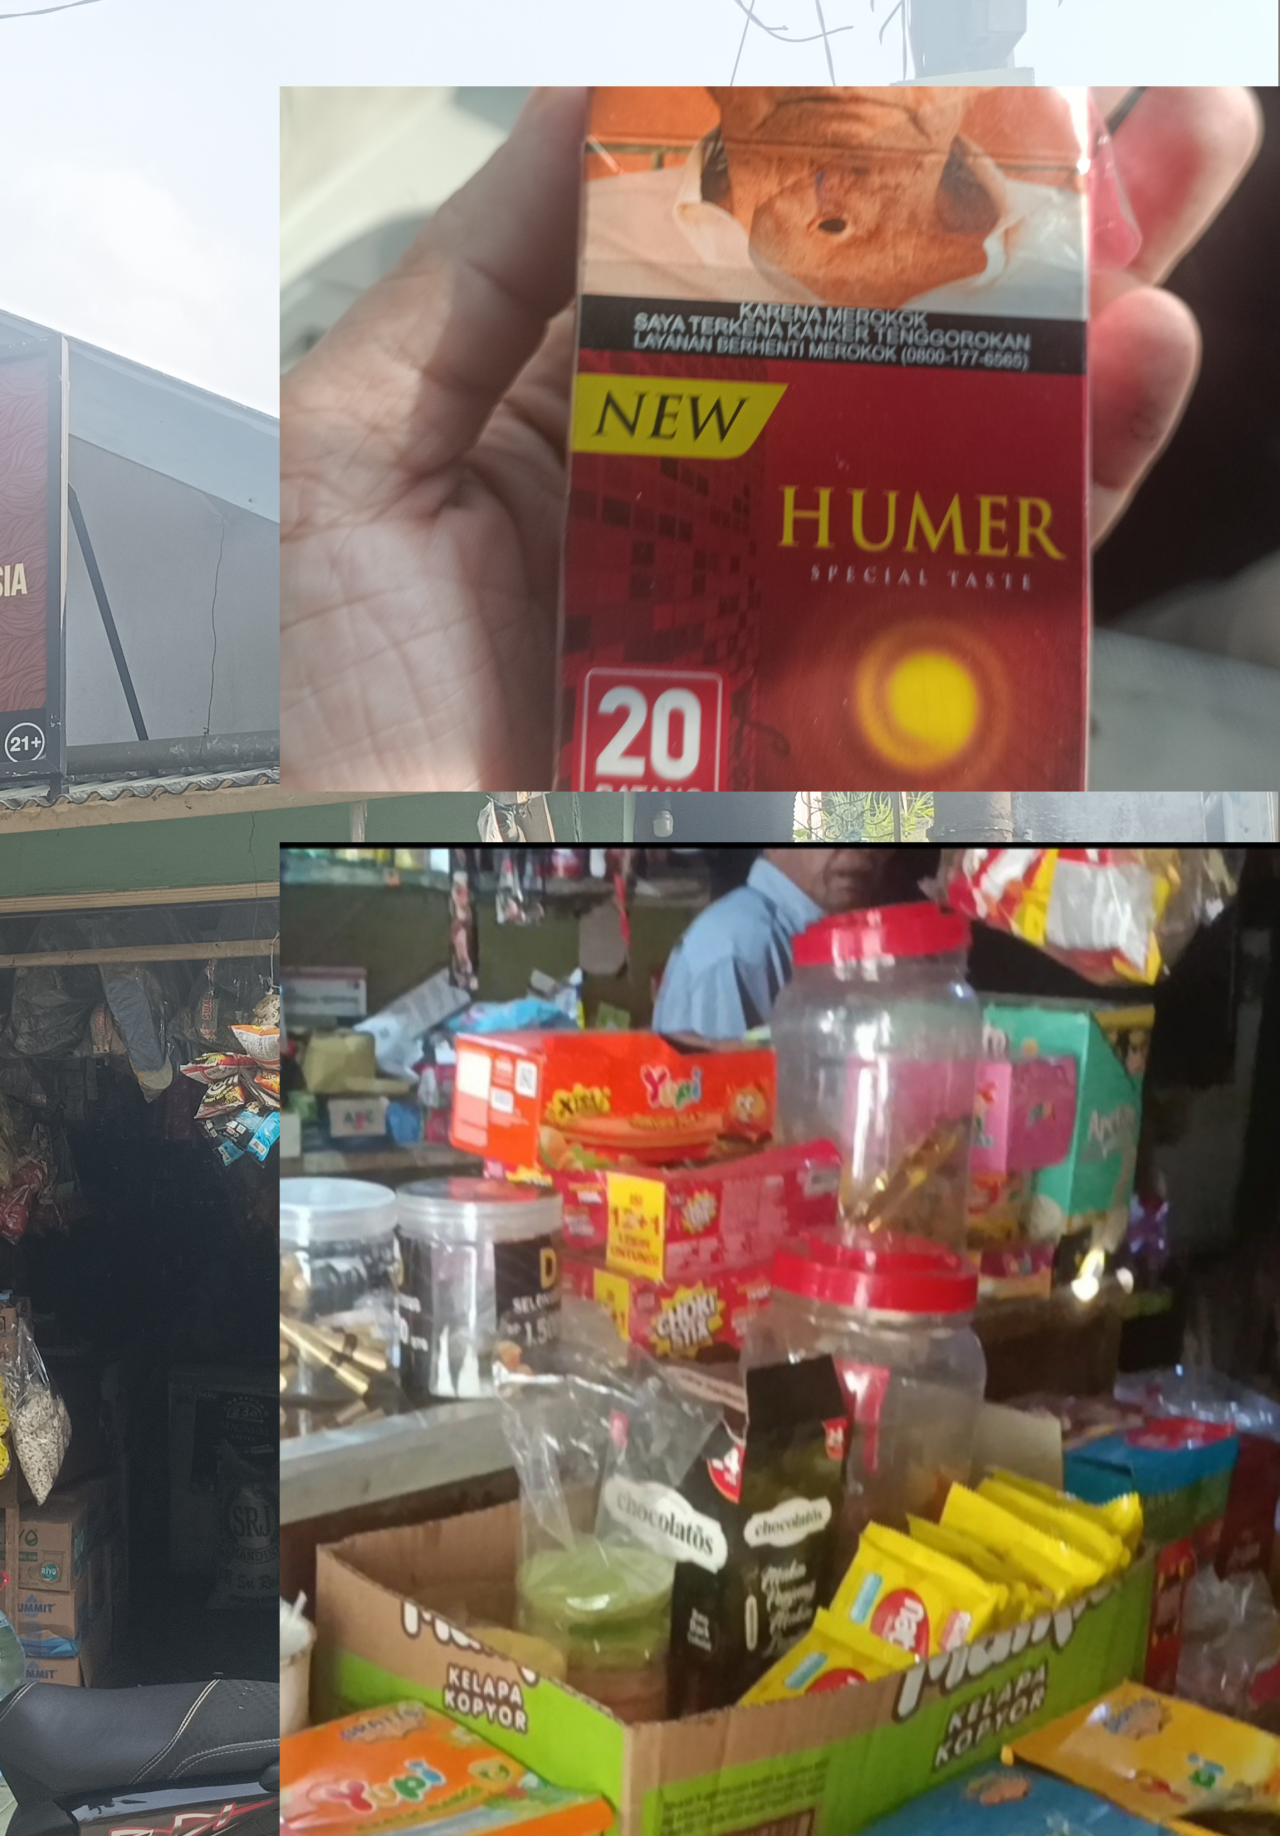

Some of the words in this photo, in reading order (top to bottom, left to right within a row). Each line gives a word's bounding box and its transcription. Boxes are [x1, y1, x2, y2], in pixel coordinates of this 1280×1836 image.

[634, 312, 686, 333] SAYA
[688, 315, 784, 339] TERKENA
[787, 322, 869, 343] KANKER
[873, 326, 1031, 350] TENGGOROKAN
[740, 302, 823, 323] KARENA
[826, 306, 928, 329] MEROKOK
[634, 331, 713, 351] LAYANAN
[716, 335, 804, 357] BERHENTI
[809, 340, 897, 362] MEROKOK
[592, 390, 750, 443] NEW
[777, 485, 1067, 561] HUMER
[810, 564, 929, 587] SPECIAL
[948, 569, 1032, 591] TASTE
[9, 736, 42, 753] 21+
[596, 685, 703, 781] 20
[18, 1603, 53, 1613] UMMIT
[25, 1669, 55, 1679] MMIT
[447, 1664, 524, 1707] KELAPA
[443, 1689, 528, 1734] KOPYOR
